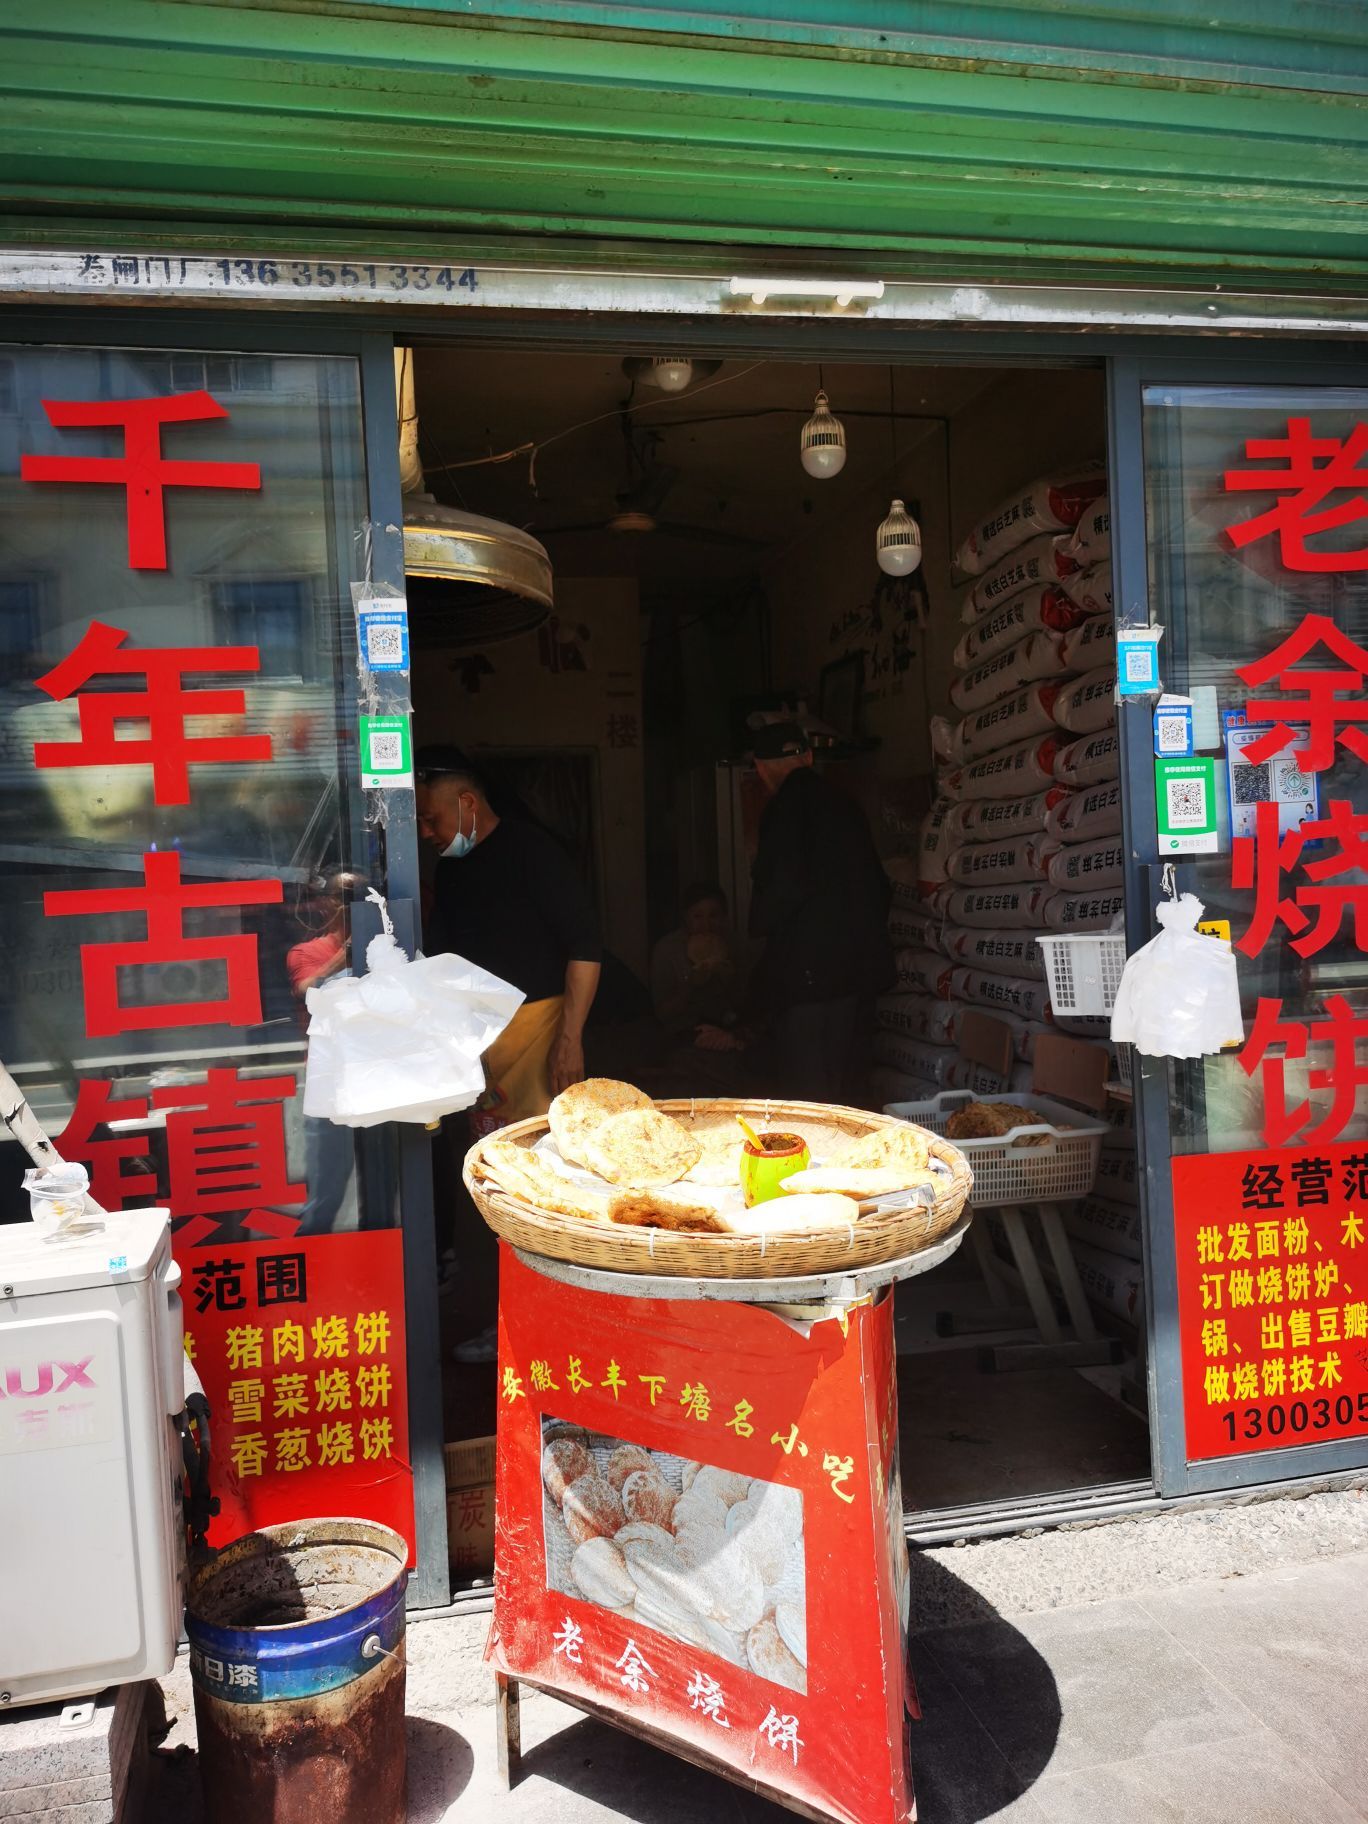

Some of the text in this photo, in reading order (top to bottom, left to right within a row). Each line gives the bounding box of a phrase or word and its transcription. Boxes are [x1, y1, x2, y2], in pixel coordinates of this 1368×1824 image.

[192, 1252, 308, 1314] 范围
[225, 1310, 391, 1371] 猪肉烧饼
[0, 1355, 97, 1399] UX
[228, 1363, 393, 1423] 雪菜烧饼
[1203, 1351, 1342, 1406] 做烧饼技术
[230, 1416, 394, 1479] 香葱烧饼
[502, 1355, 856, 1503] 安徽长丰下塘名小吃
[552, 1616, 806, 1766] 老余烧饼
